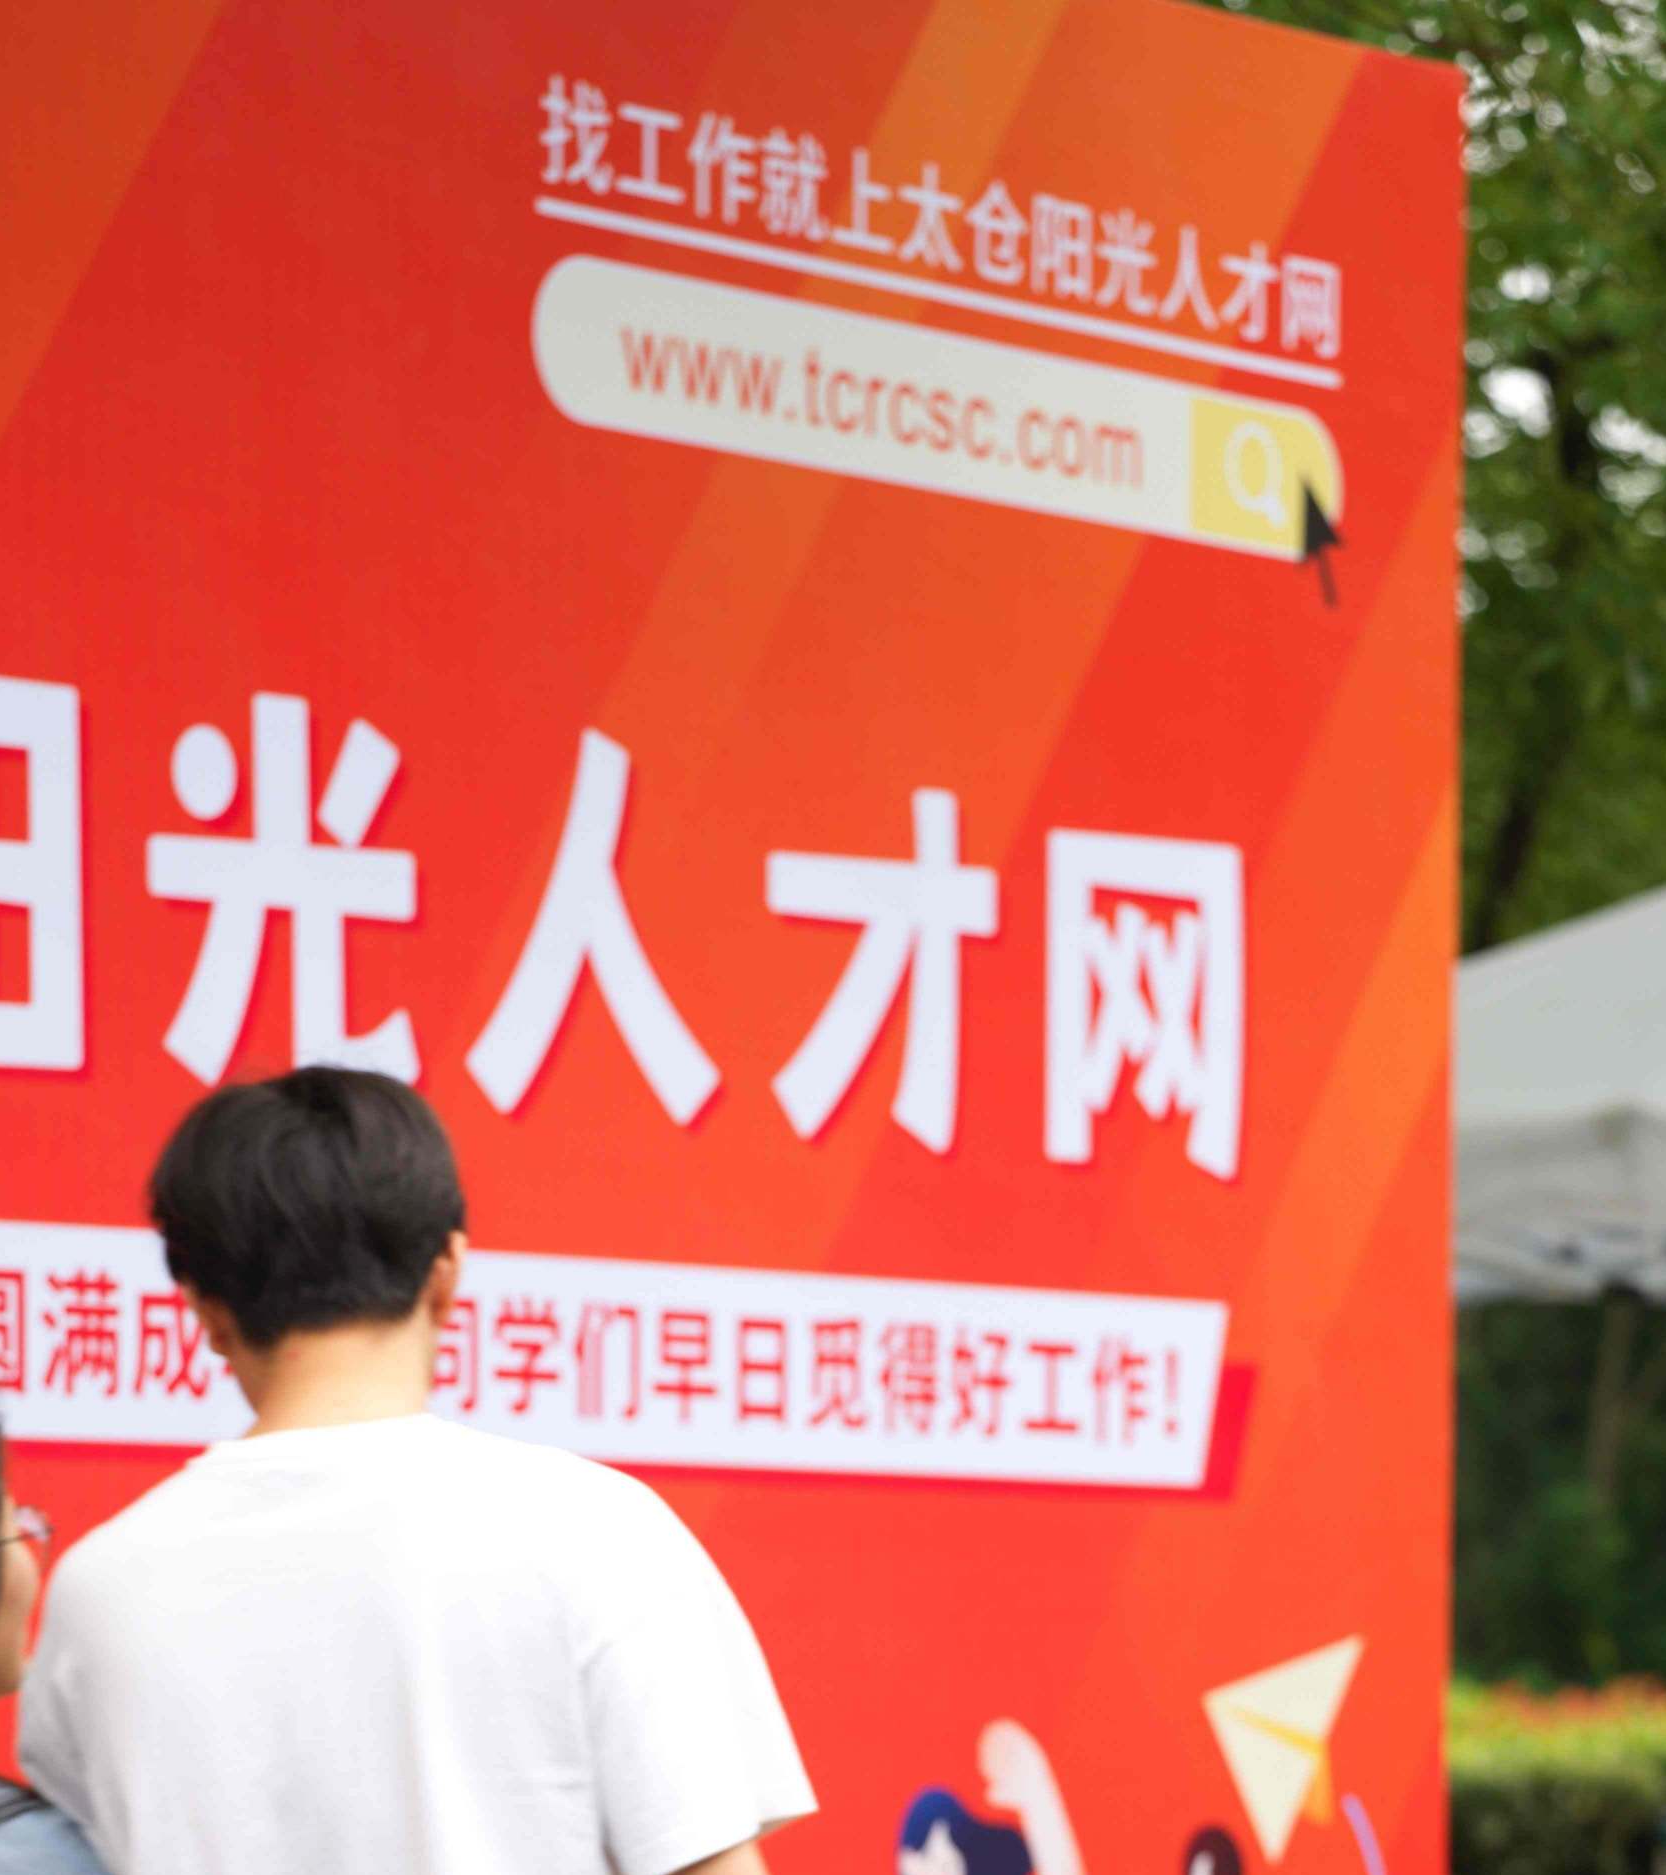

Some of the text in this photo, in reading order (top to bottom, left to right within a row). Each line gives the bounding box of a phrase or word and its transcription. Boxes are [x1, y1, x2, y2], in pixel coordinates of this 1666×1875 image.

[541, 74, 1342, 360] 找工作就上太仓阳光人才网
[619, 322, 1147, 490] www.tcrcsc.com
